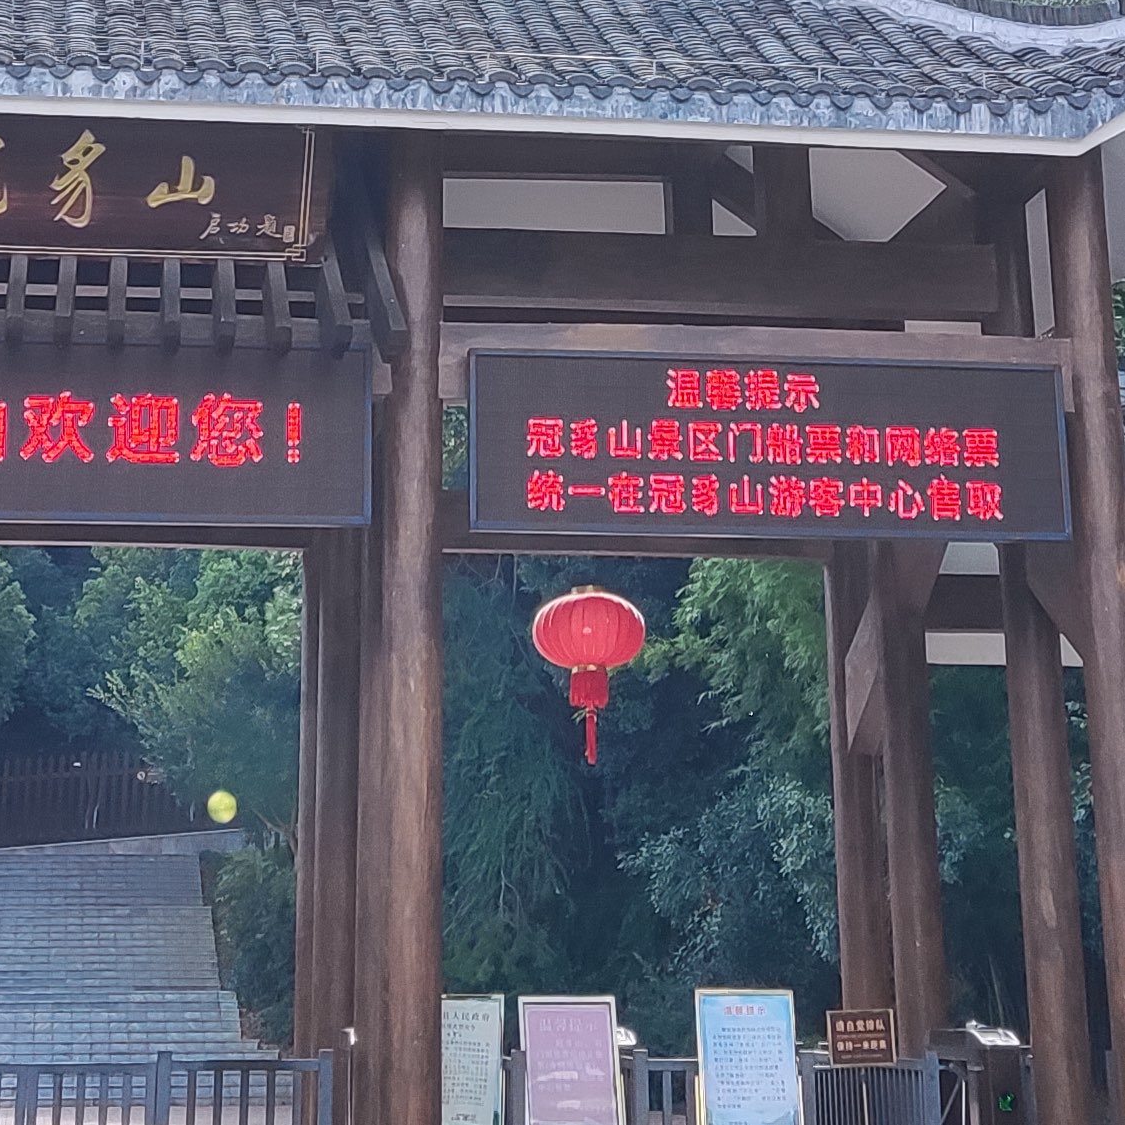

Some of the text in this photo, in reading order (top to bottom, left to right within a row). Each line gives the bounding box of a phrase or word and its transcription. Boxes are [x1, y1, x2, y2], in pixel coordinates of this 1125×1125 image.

[666, 368, 819, 413] 温馨提示
[526, 416, 999, 468] 冠豸山景区门船票和网络票
[526, 471, 1003, 521] 统一在冠豸山游客中心售取
